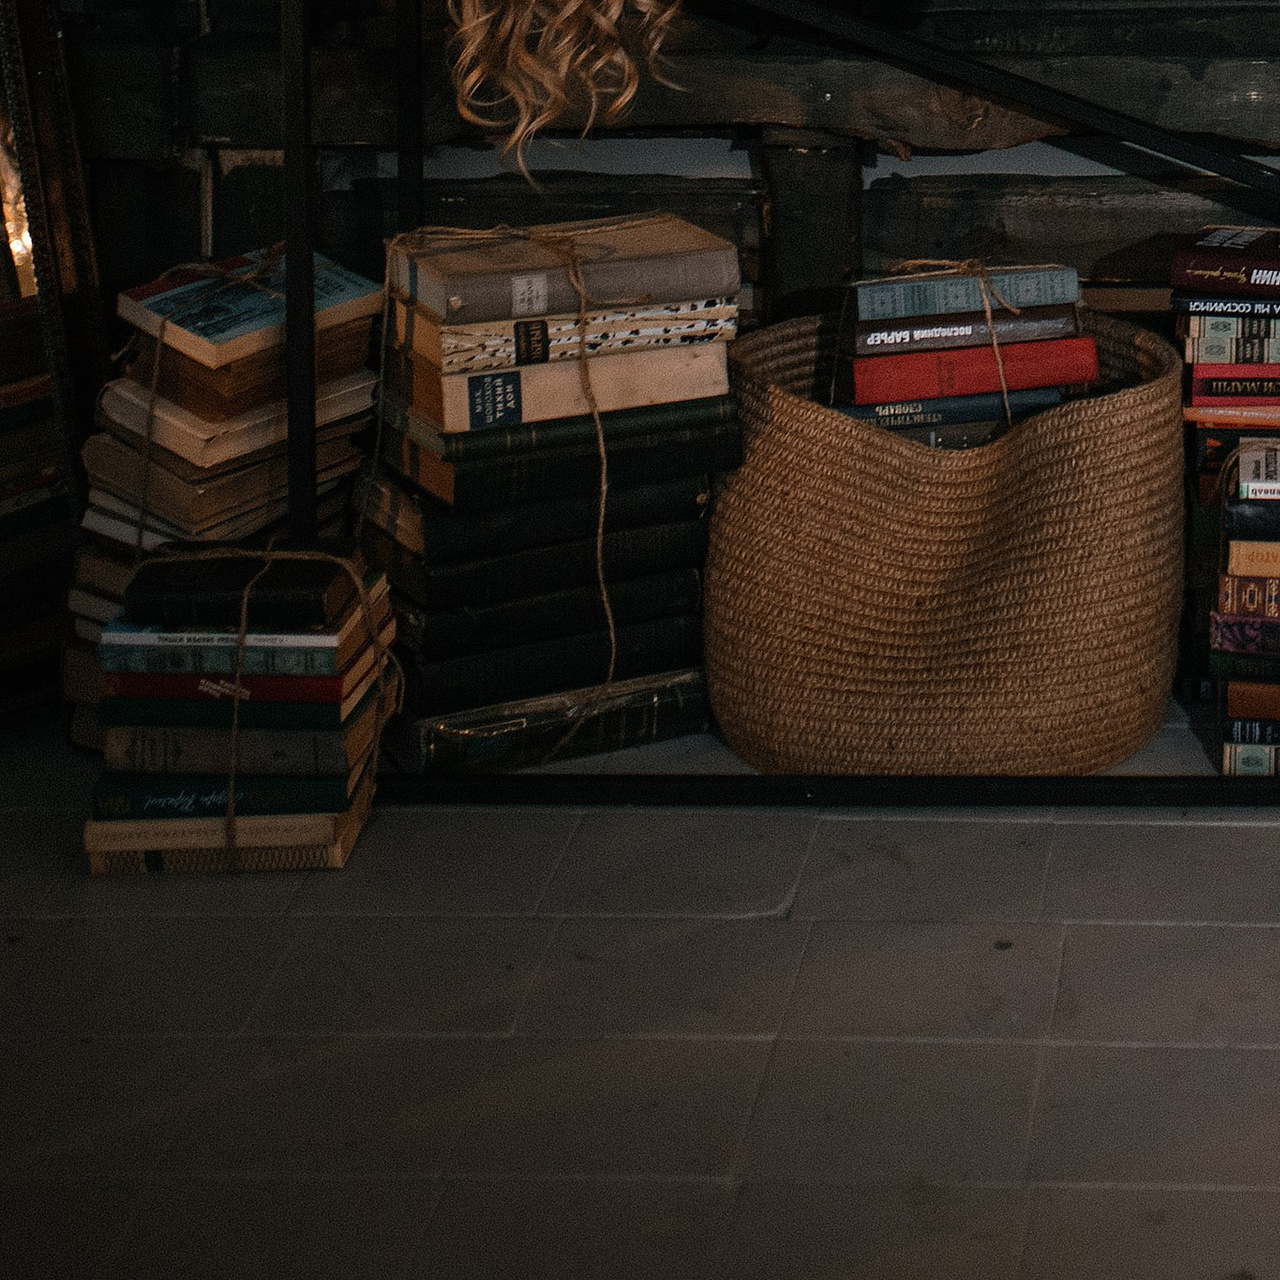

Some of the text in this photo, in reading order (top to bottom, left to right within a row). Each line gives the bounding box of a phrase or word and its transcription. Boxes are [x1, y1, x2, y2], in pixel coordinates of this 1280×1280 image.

[1189, 301, 1253, 313] СОСТАРИМСЯ
[1254, 302, 1270, 314] МЫ
[866, 330, 910, 345] БАРЬЕР
[1212, 382, 1260, 394] МАРШ
[484, 376, 493, 424] ШОЛОХОВ
[495, 378, 504, 419] ТИХИЙ
[506, 384, 516, 409] ДОН
